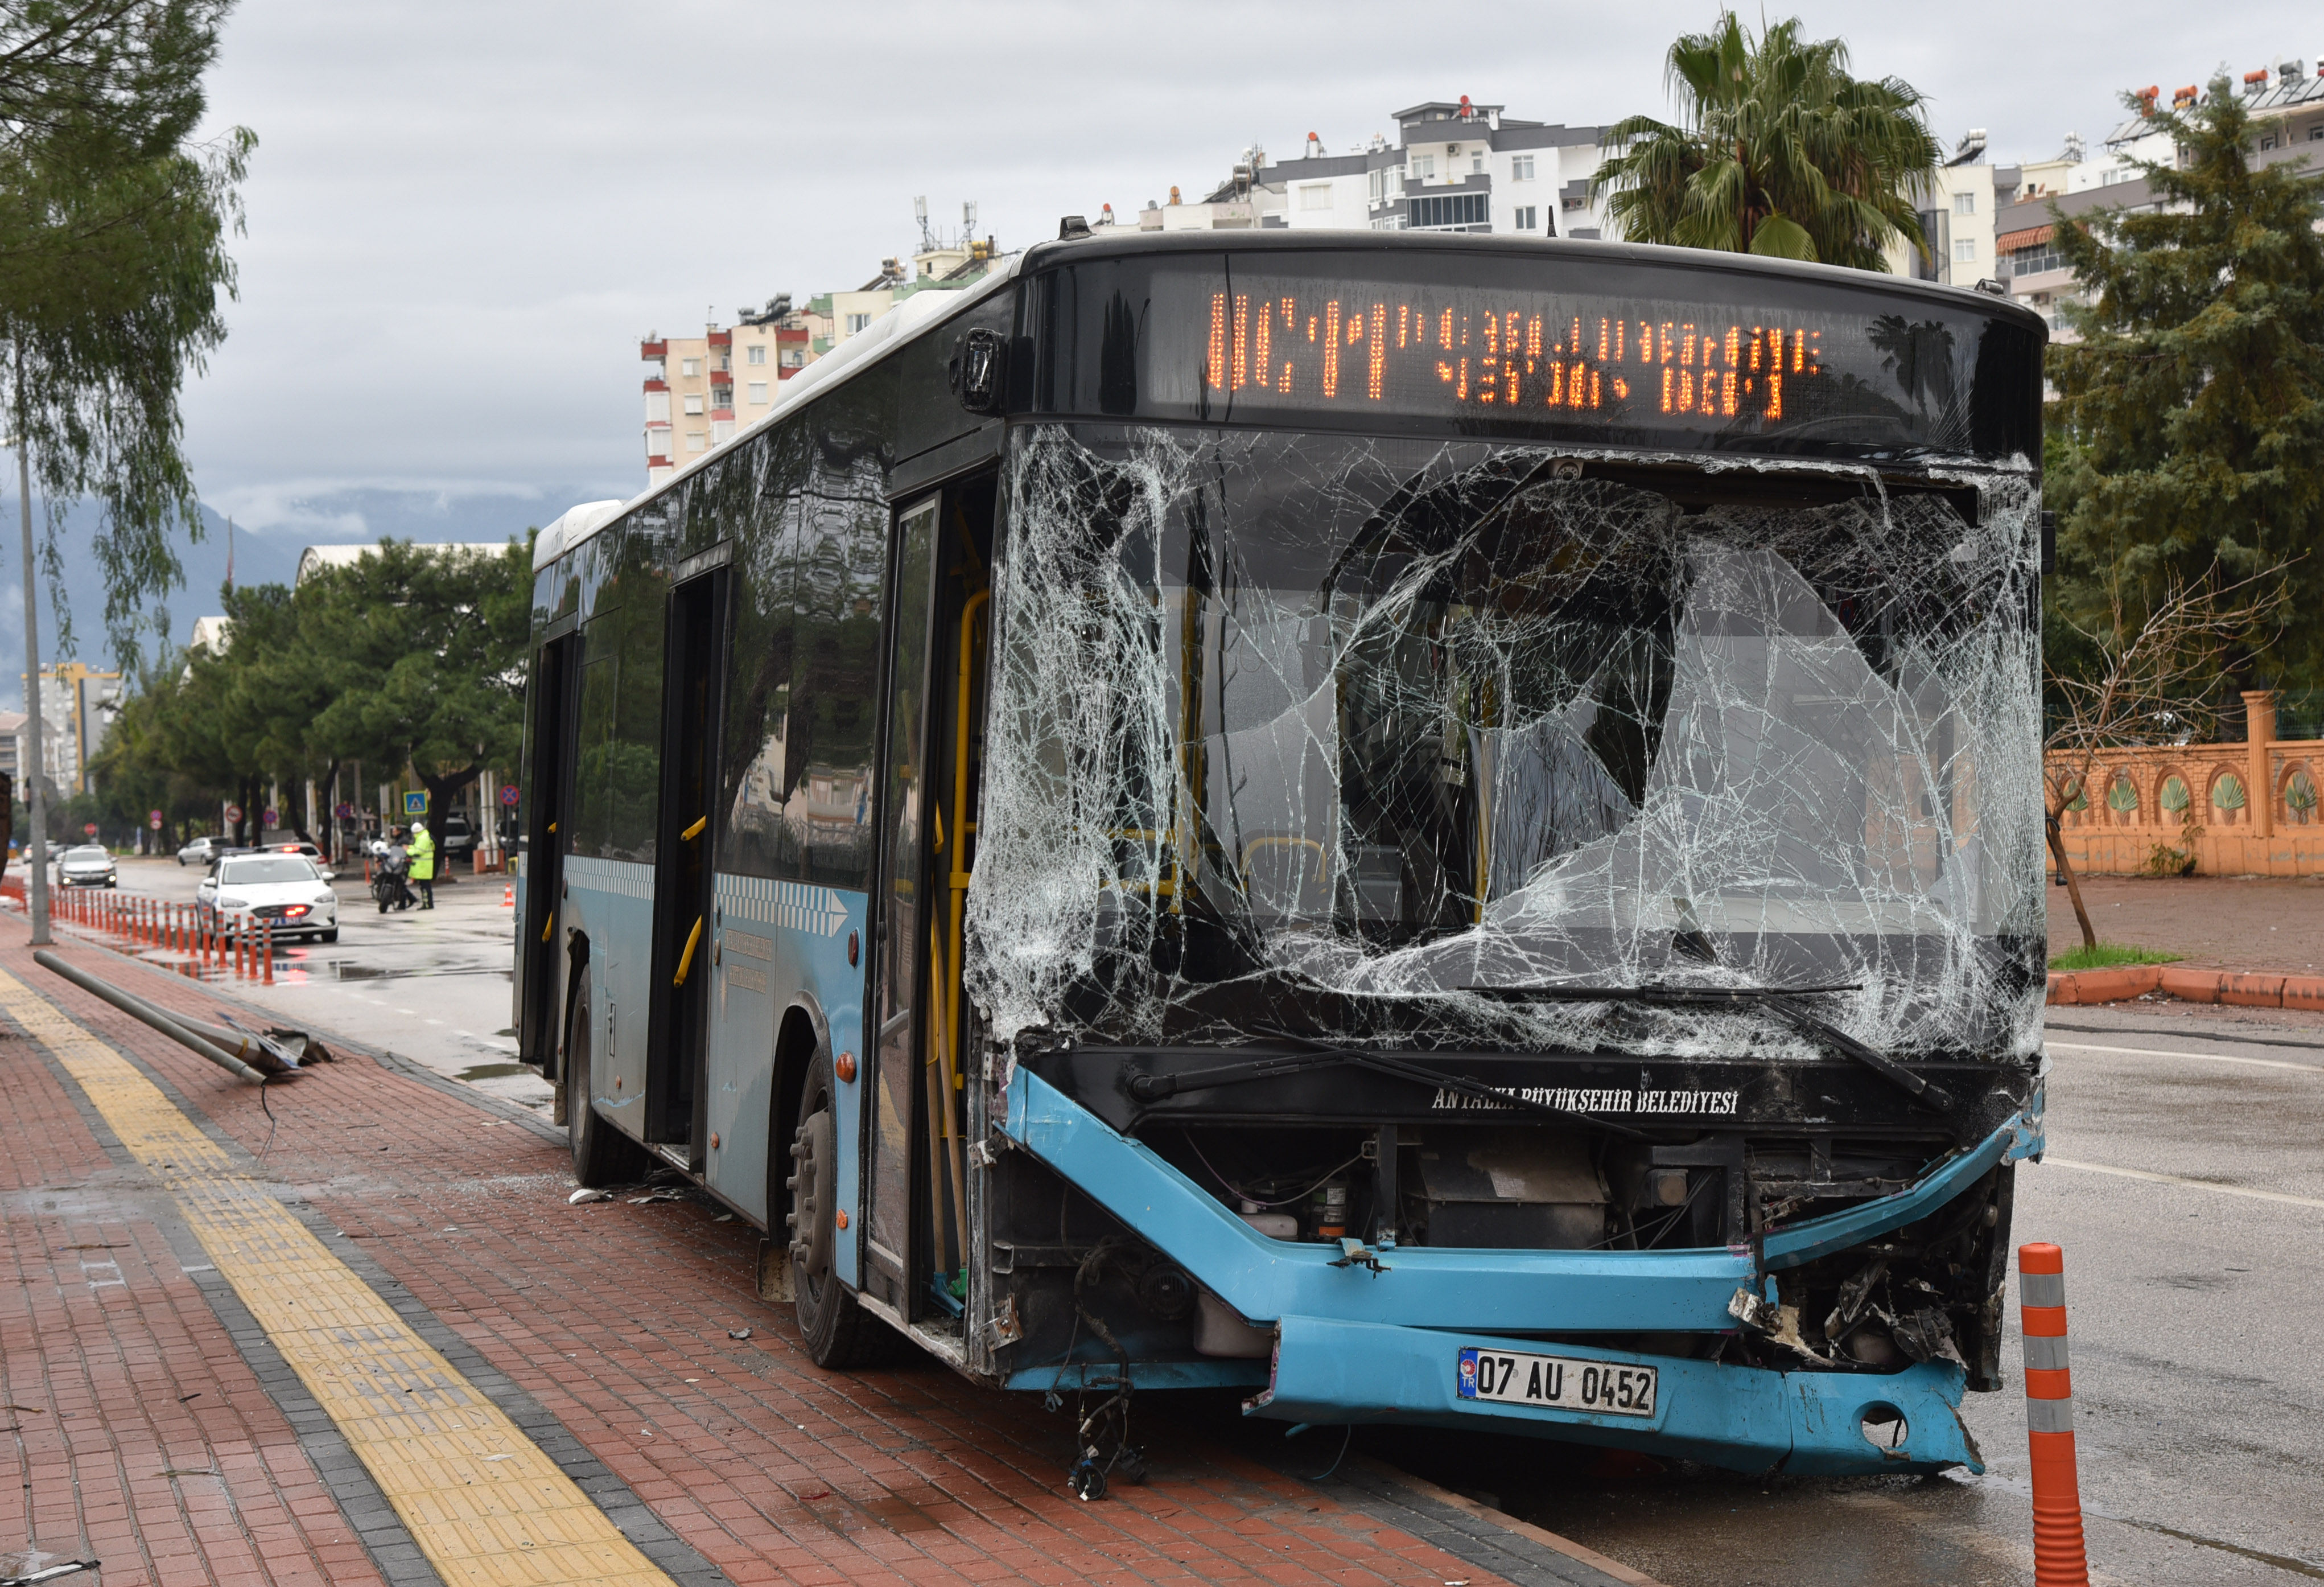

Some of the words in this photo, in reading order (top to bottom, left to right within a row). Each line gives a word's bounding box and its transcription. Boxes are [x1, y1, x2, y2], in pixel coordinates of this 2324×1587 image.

[1635, 1090, 1738, 1114] BELEDİYESİ
[1462, 1377, 1475, 1388] TR
[1477, 1356, 1515, 1395] 07
[1526, 1361, 1563, 1400] AU
[1582, 1367, 1650, 1410] 0452
